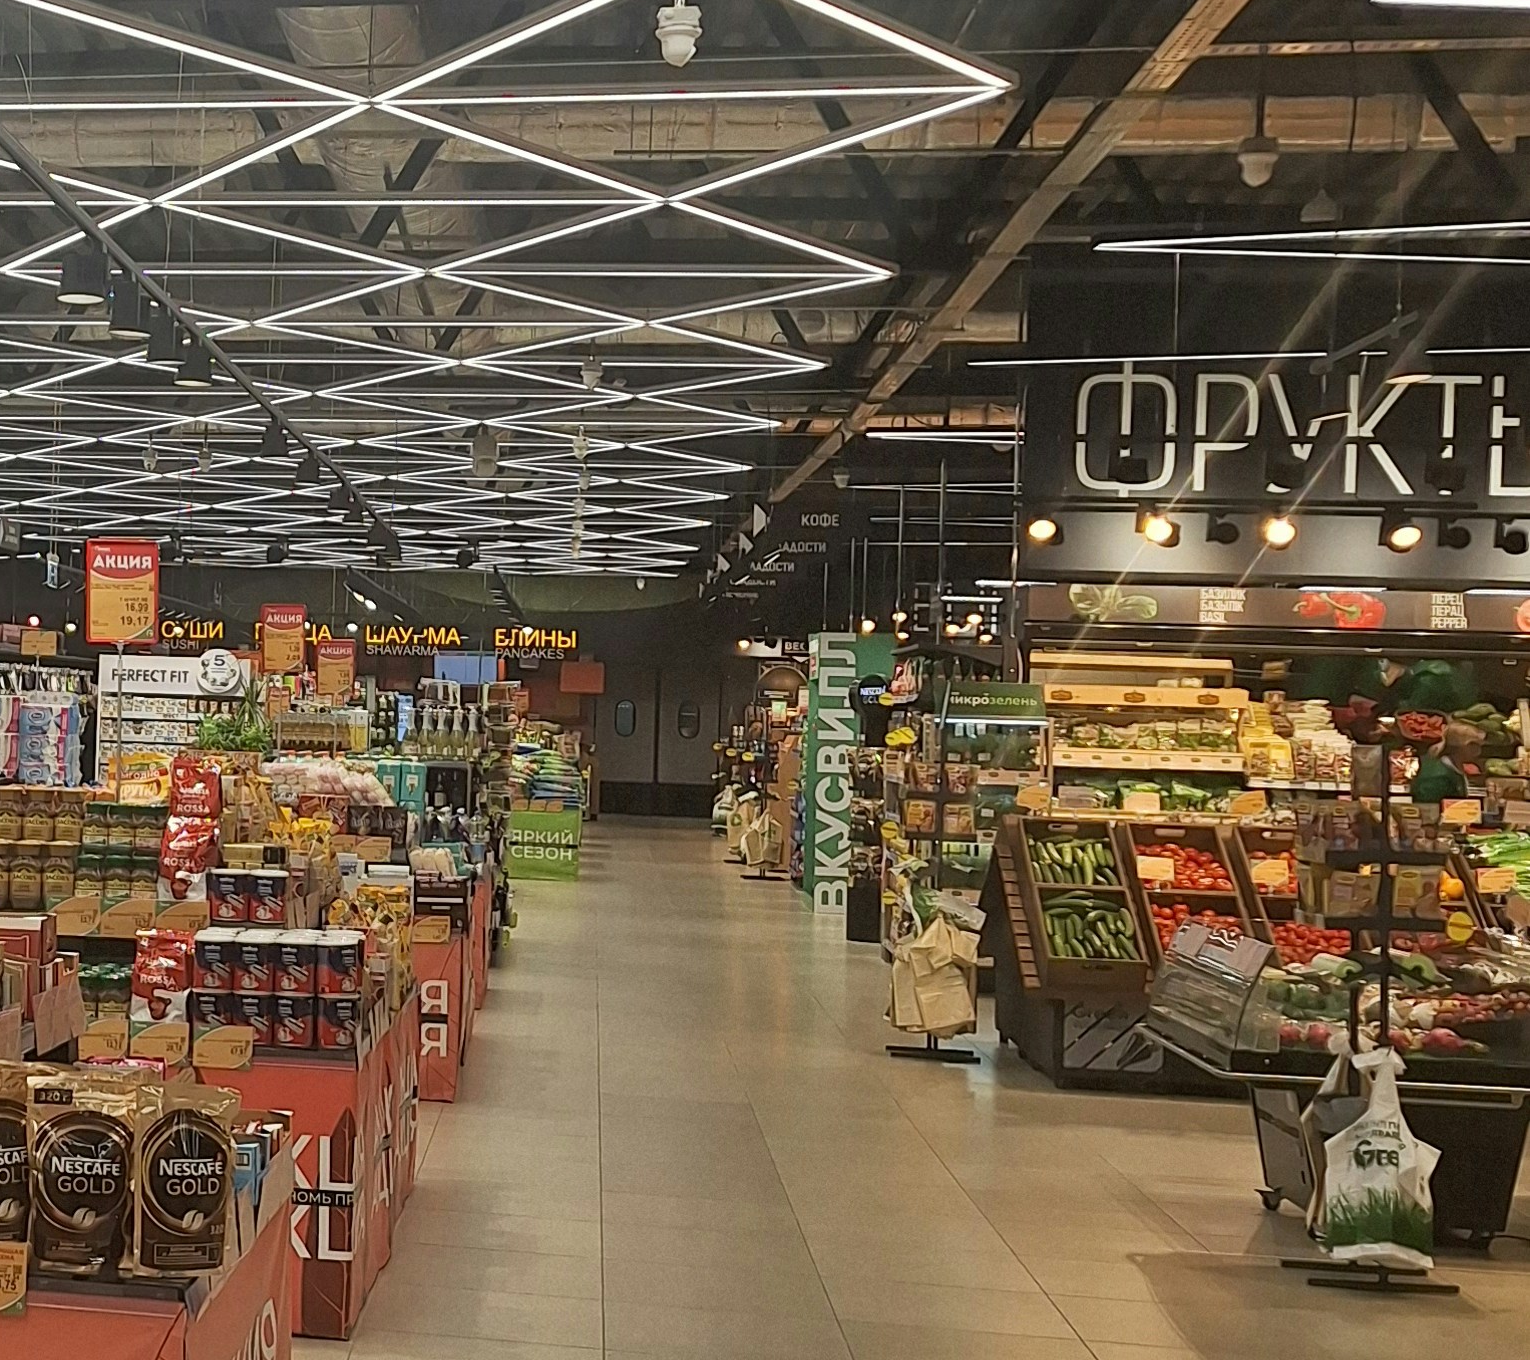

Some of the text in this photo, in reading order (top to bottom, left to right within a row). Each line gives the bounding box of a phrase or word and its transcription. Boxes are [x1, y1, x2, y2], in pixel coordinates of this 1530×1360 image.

[800, 514, 841, 528] КОФЕ
[92, 554, 153, 570] АКЦИЯ
[1430, 593, 1464, 606] ПЕРЕЦ
[1199, 611, 1227, 624] BASIL
[1430, 605, 1465, 618] ПЕРАЦ
[120, 615, 149, 626] 19,17
[266, 613, 303, 624] АКЦИЯ
[1430, 616, 1468, 629] PEPPER
[161, 621, 224, 639] СУШИ
[366, 625, 461, 645] ШАУРМА
[161, 639, 200, 651] SUSHI
[494, 628, 577, 649] БЛИНЫ
[320, 646, 353, 655] АКЦИЯ
[366, 645, 440, 657] SHAWARMA
[494, 648, 565, 660] PANCAKES
[213, 654, 226, 667] 5
[111, 668, 190, 683] PERFECT FIT
[176, 804, 211, 814] ROSSA
[511, 828, 574, 845] ЯРКИЙ
[510, 845, 573, 862] СЕЗОН
[139, 974, 176, 986] ROSSA
[39, 1090, 61, 1102] 320
[57, 1178, 117, 1195] GOLD
[165, 1178, 221, 1196] GOLD
